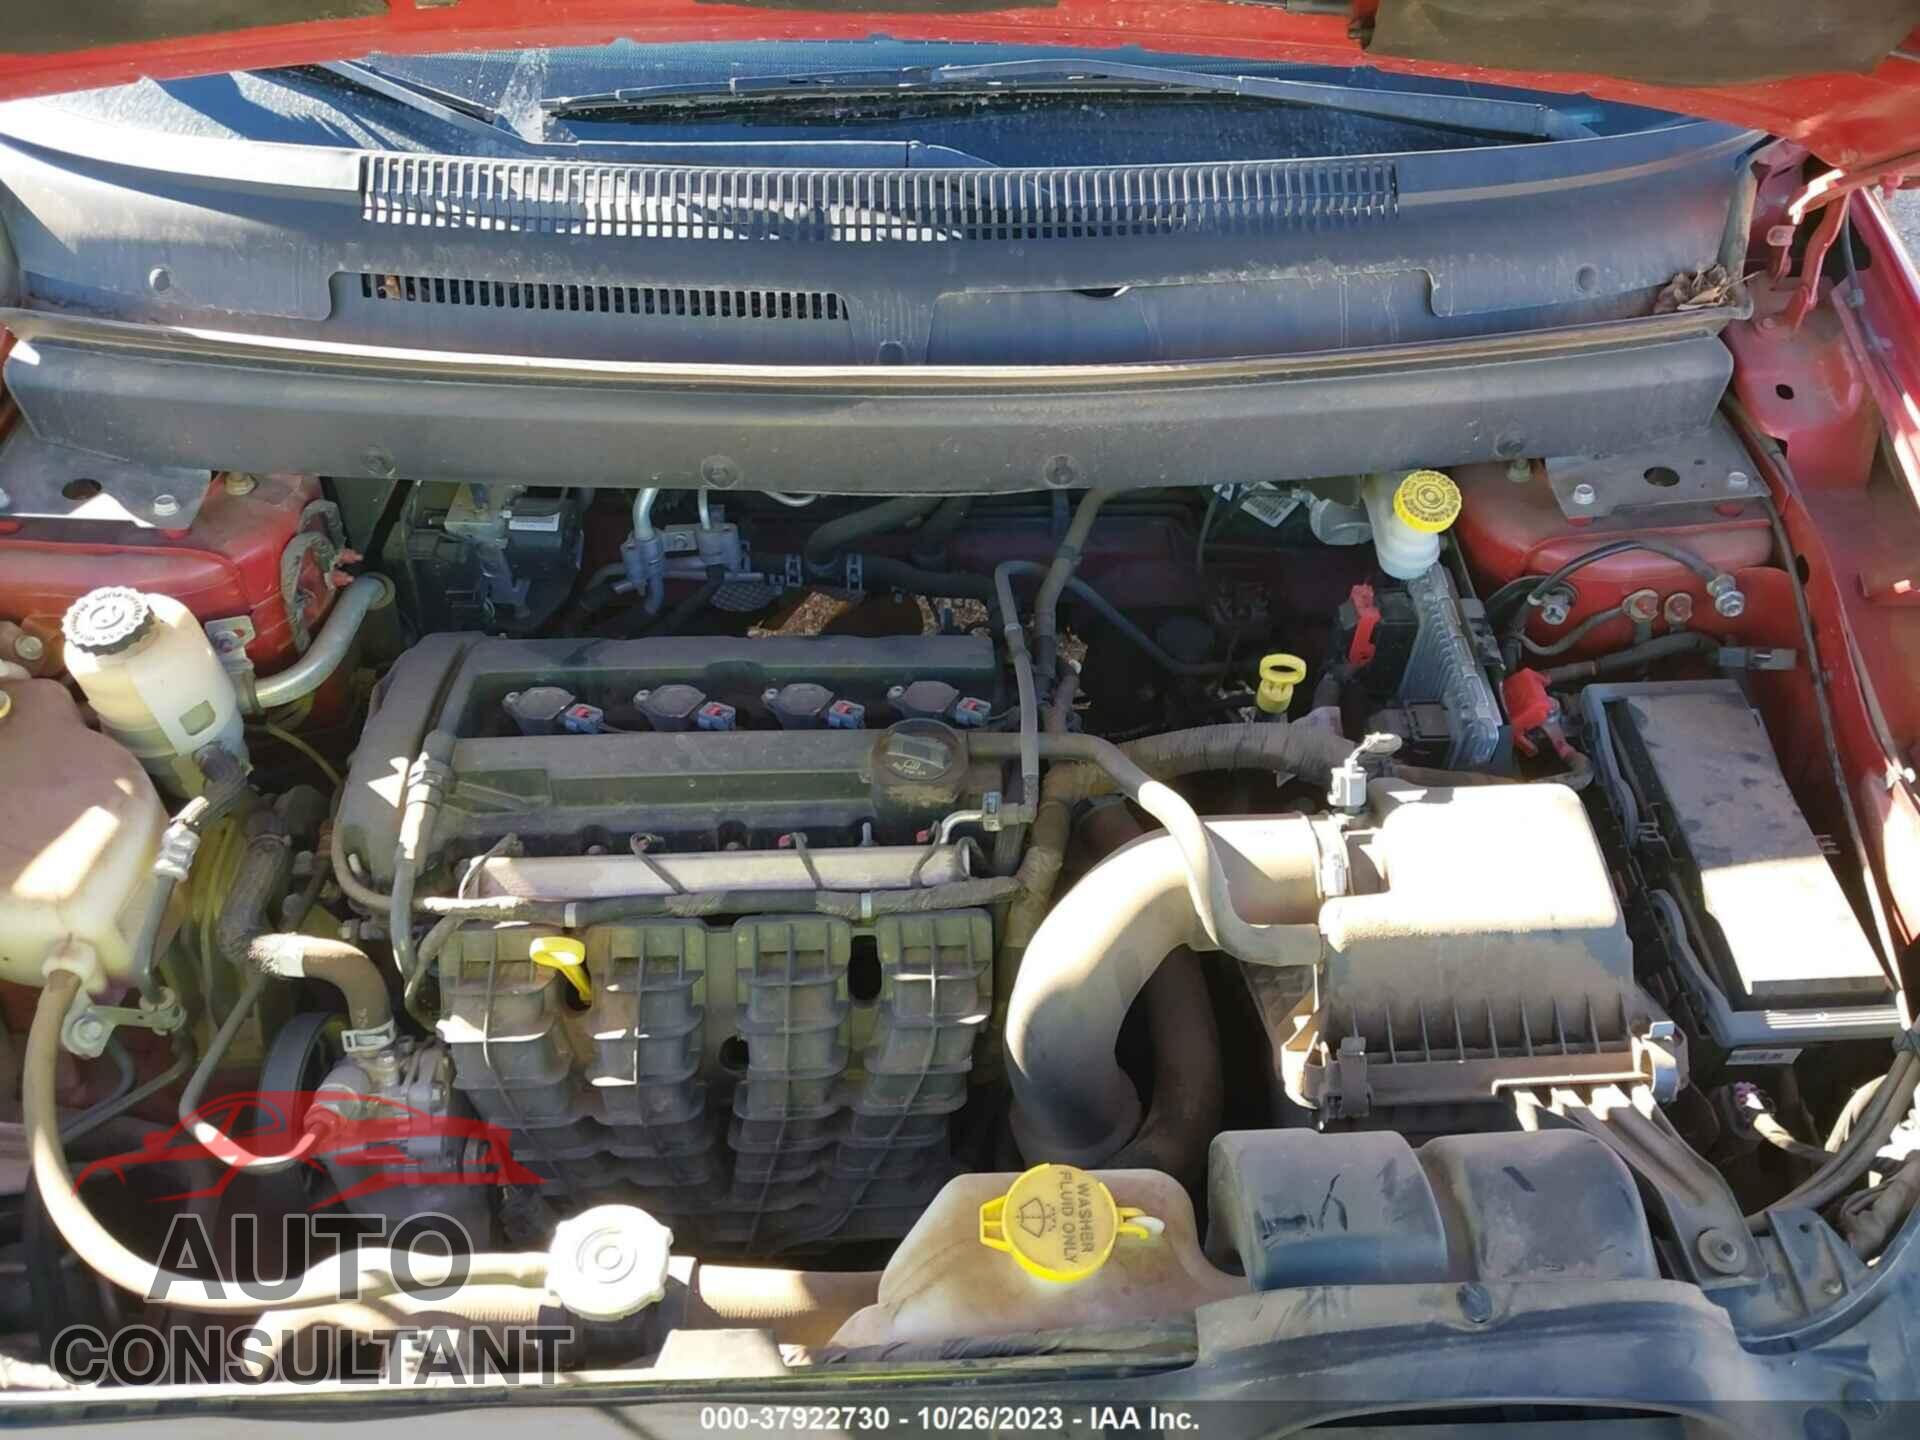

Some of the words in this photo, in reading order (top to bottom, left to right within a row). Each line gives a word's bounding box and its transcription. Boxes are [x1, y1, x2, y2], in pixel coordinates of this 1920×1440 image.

[1060, 1170, 1074, 1218] FLUID
[1077, 1183, 1094, 1253] WASHER
[1062, 1220, 1079, 1264] ONLY
